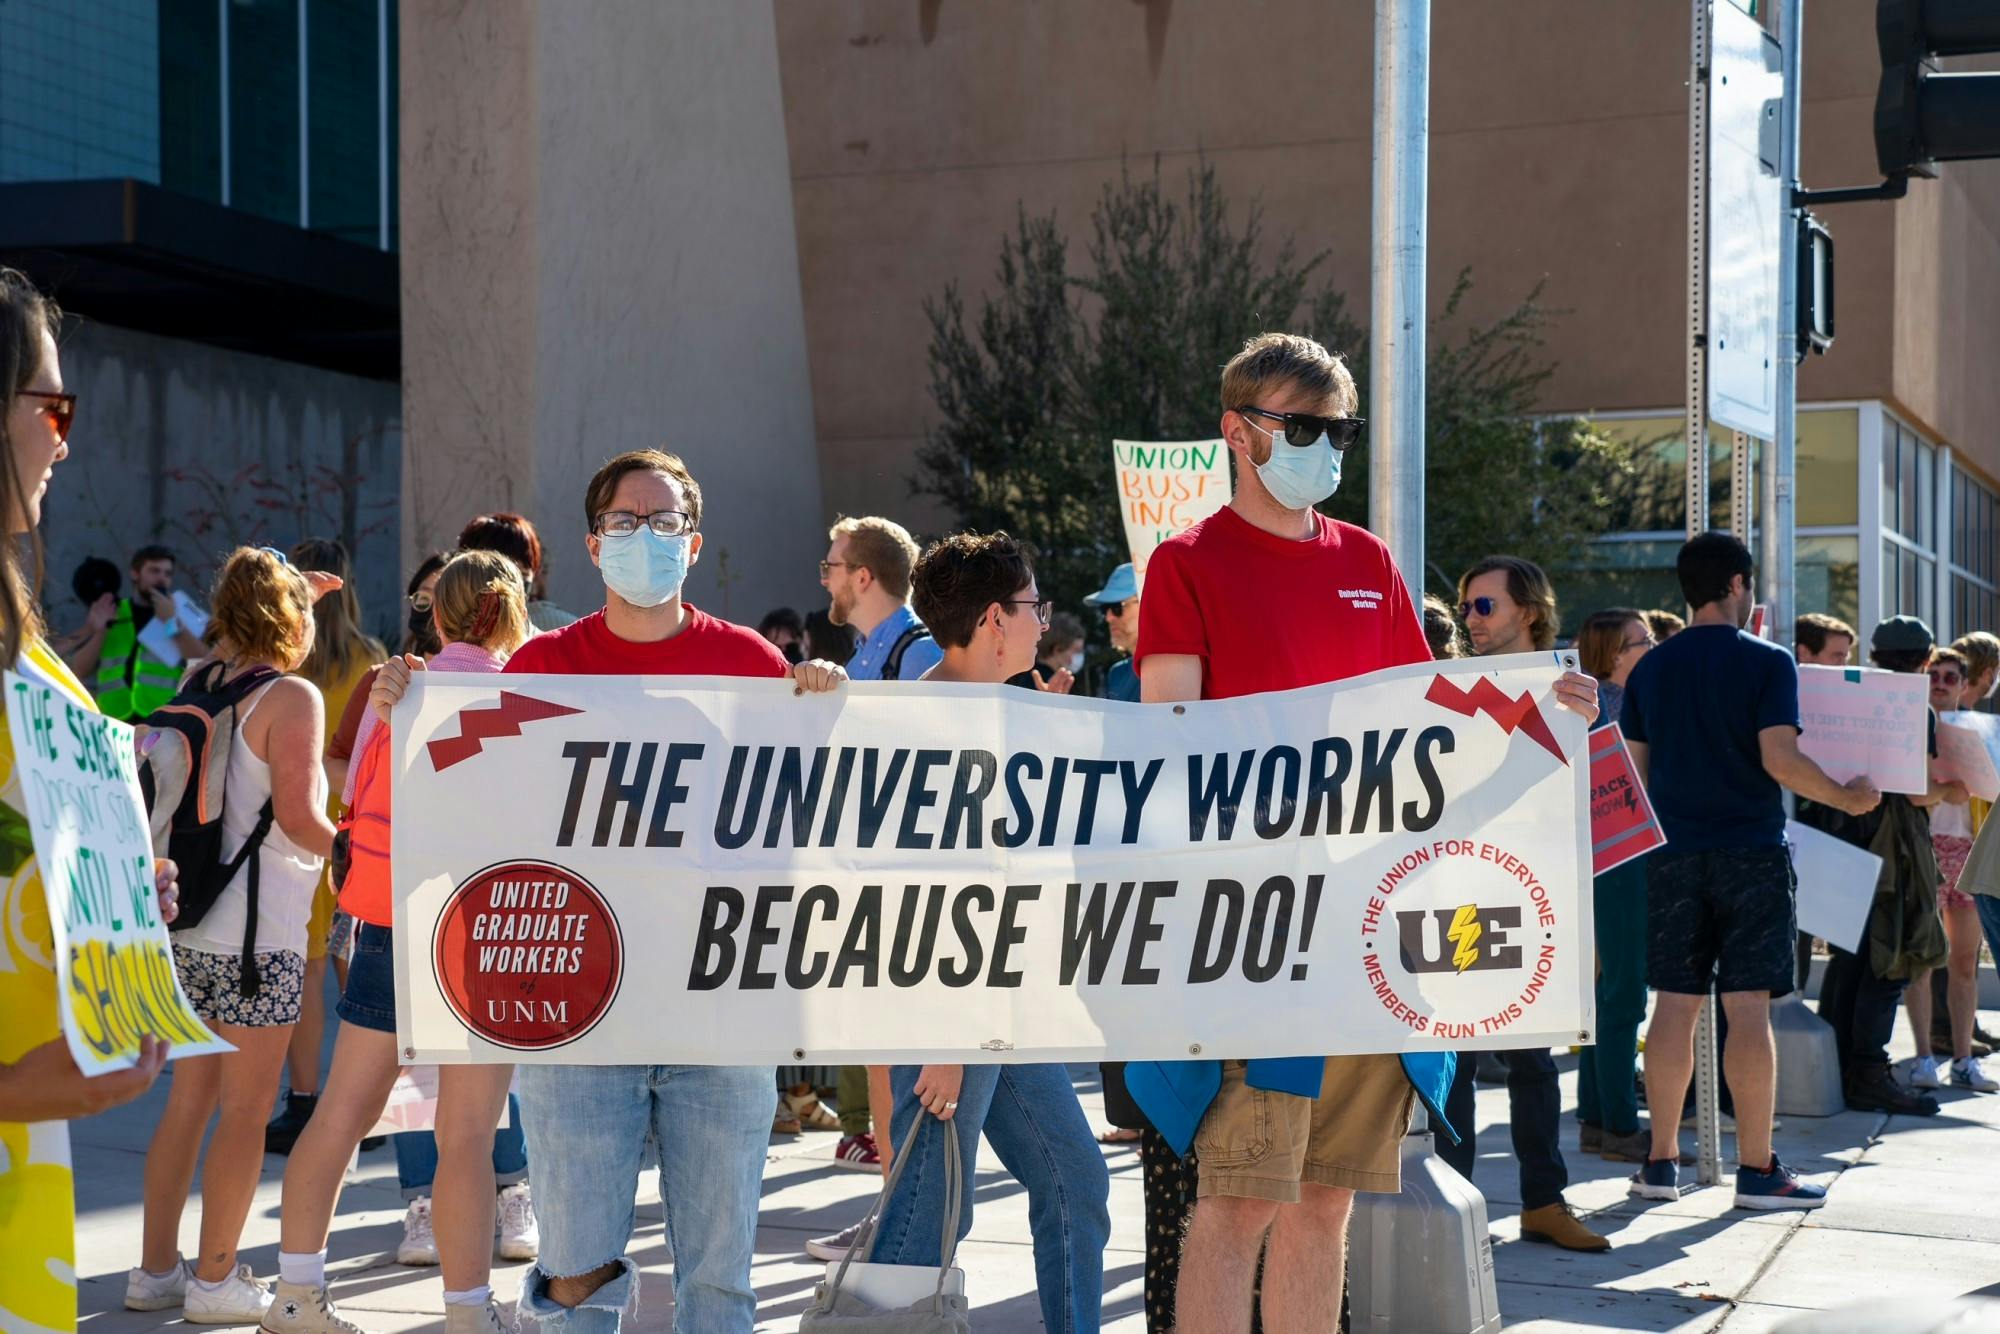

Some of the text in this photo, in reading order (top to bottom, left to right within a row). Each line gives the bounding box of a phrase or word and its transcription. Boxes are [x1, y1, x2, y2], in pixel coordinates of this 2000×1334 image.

[1116, 443, 1218, 471] UNION
[1121, 470, 1225, 502] BUST-
[1130, 500, 1194, 529] ING
[1338, 589, 1360, 599] United
[1351, 599, 1378, 609] Workers
[14, 682, 58, 762] THE
[556, 725, 1455, 849] THE UNIVERSITY WORKS
[50, 846, 155, 933] UNTIL WE
[489, 881, 569, 909] UNITED
[1362, 840, 1556, 936] THE UNION FOR EVERYONE
[472, 913, 589, 941] GRADUATE
[687, 874, 1325, 991] BECAUSE WE DO!
[479, 946, 583, 974] WORKERS
[519, 977, 538, 994] of
[1362, 944, 1556, 1039] MEMBERS RUN THIS UNION
[487, 1000, 569, 1023] UNM
